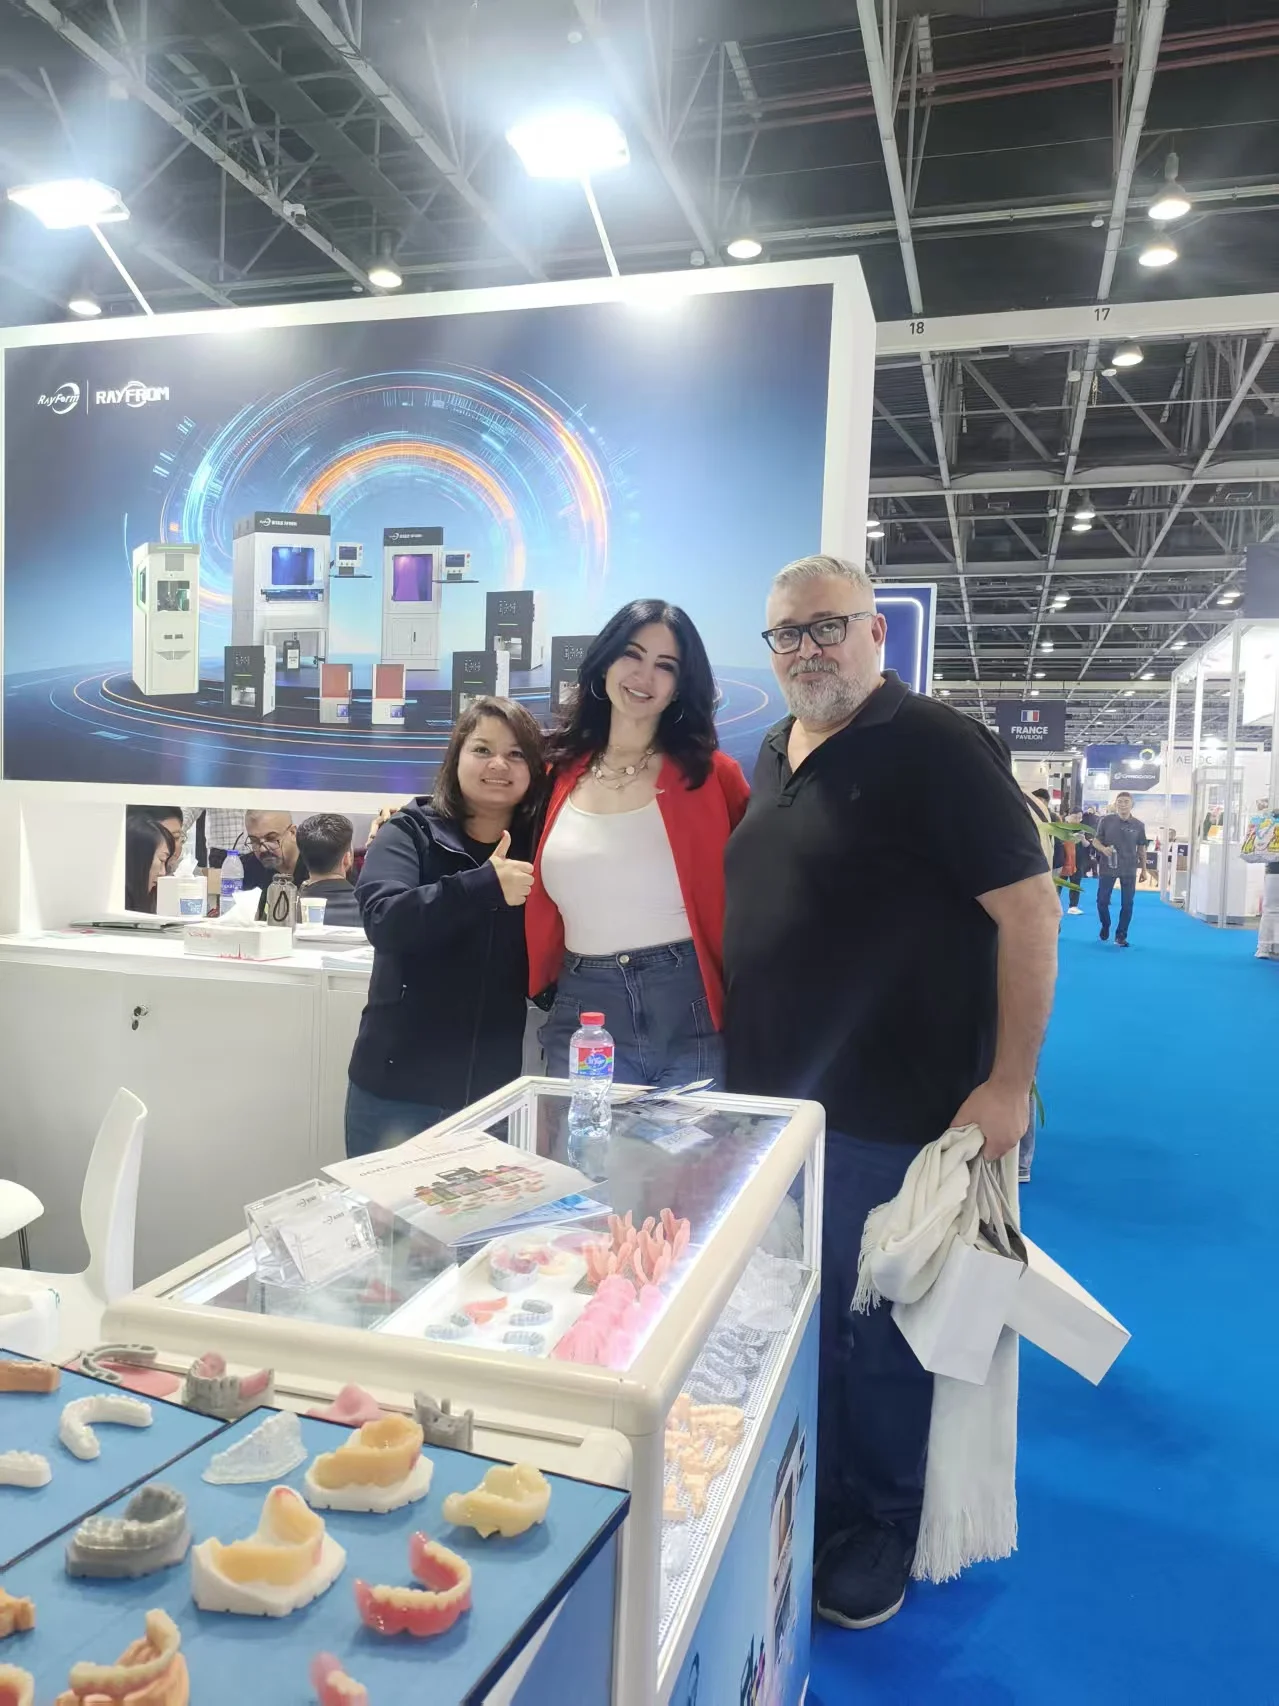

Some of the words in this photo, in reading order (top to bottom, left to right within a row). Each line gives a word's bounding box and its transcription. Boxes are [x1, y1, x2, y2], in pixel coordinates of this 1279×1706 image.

[1094, 307, 1110, 321] 17
[910, 321, 925, 335] 18
[1011, 726, 1049, 735] FRANCE
